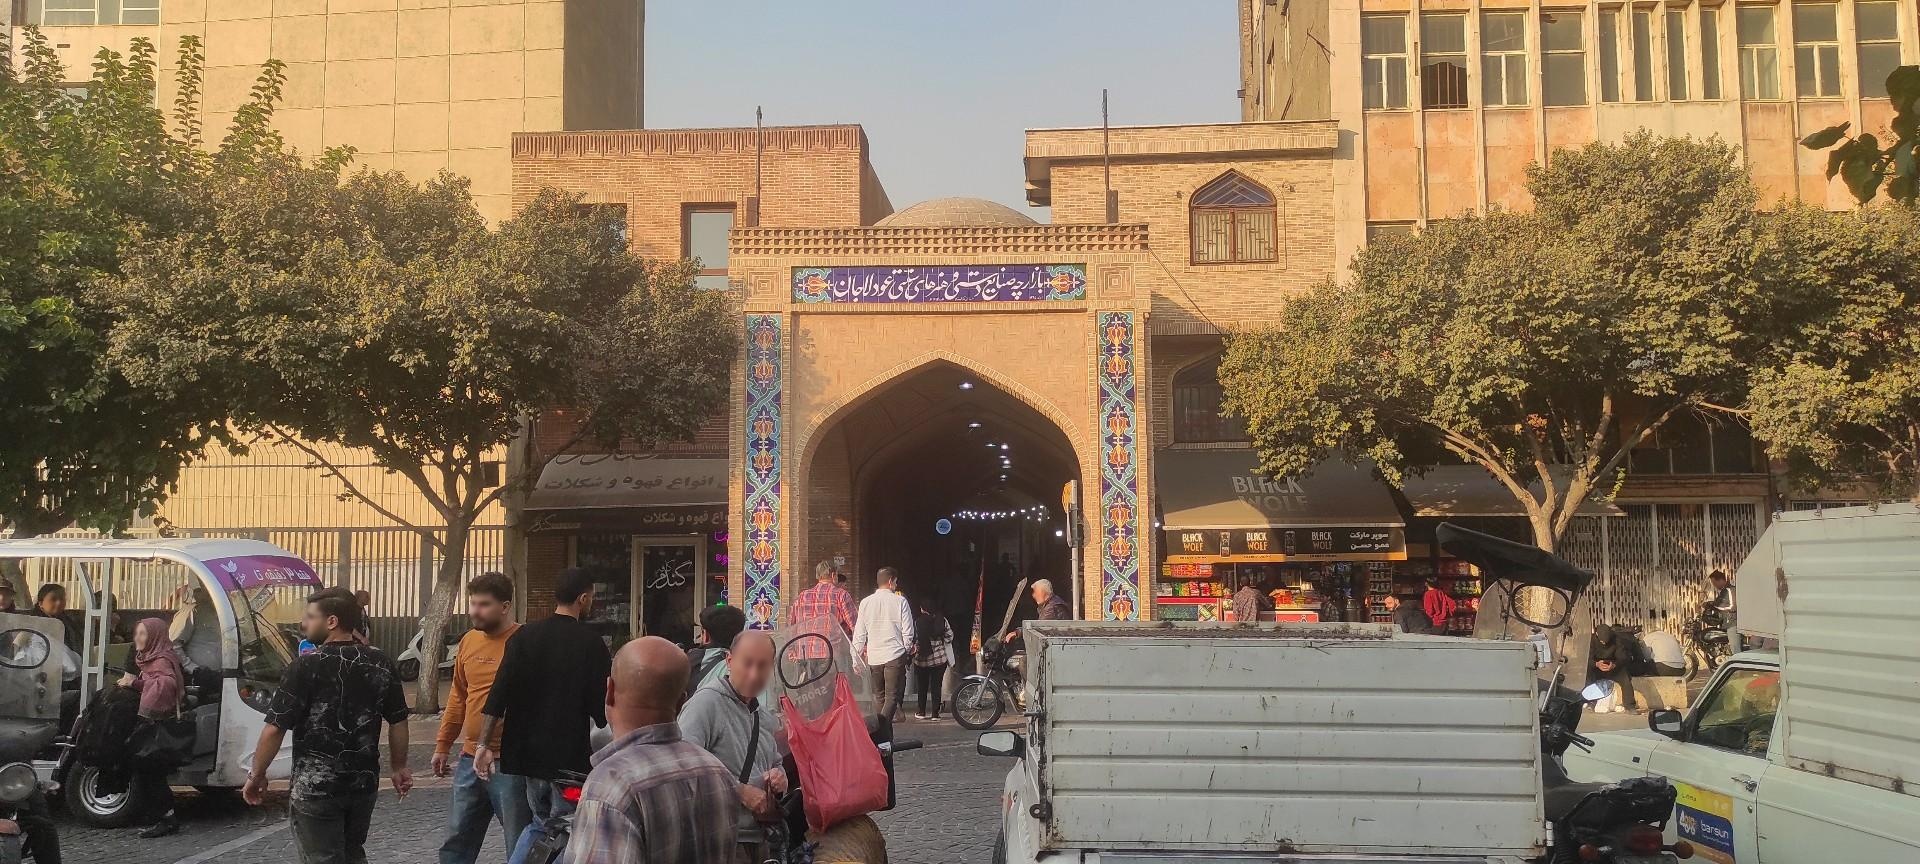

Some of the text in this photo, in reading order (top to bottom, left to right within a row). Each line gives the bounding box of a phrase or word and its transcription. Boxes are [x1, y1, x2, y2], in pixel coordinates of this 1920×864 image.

[888, 268, 920, 300] سنتی
[904, 268, 949, 300] هنرهای
[945, 270, 999, 301] دستی
[981, 267, 1016, 301] صنایع
[606, 478, 617, 489] و
[622, 475, 664, 490] قهوه
[666, 476, 714, 491] انواع
[643, 512, 676, 524] شکلات
[678, 515, 684, 526] و
[687, 511, 708, 524] قهوه
[1182, 533, 1203, 542] BLACK
[1246, 532, 1267, 541] BLACK
[1311, 531, 1332, 541] BLACK
[1349, 531, 1370, 540] مارکت
[1184, 542, 1204, 552] WOLF
[1247, 541, 1268, 551] WOLF
[1312, 540, 1333, 550] WOLF
[1701, 820, 1729, 839] barsun
